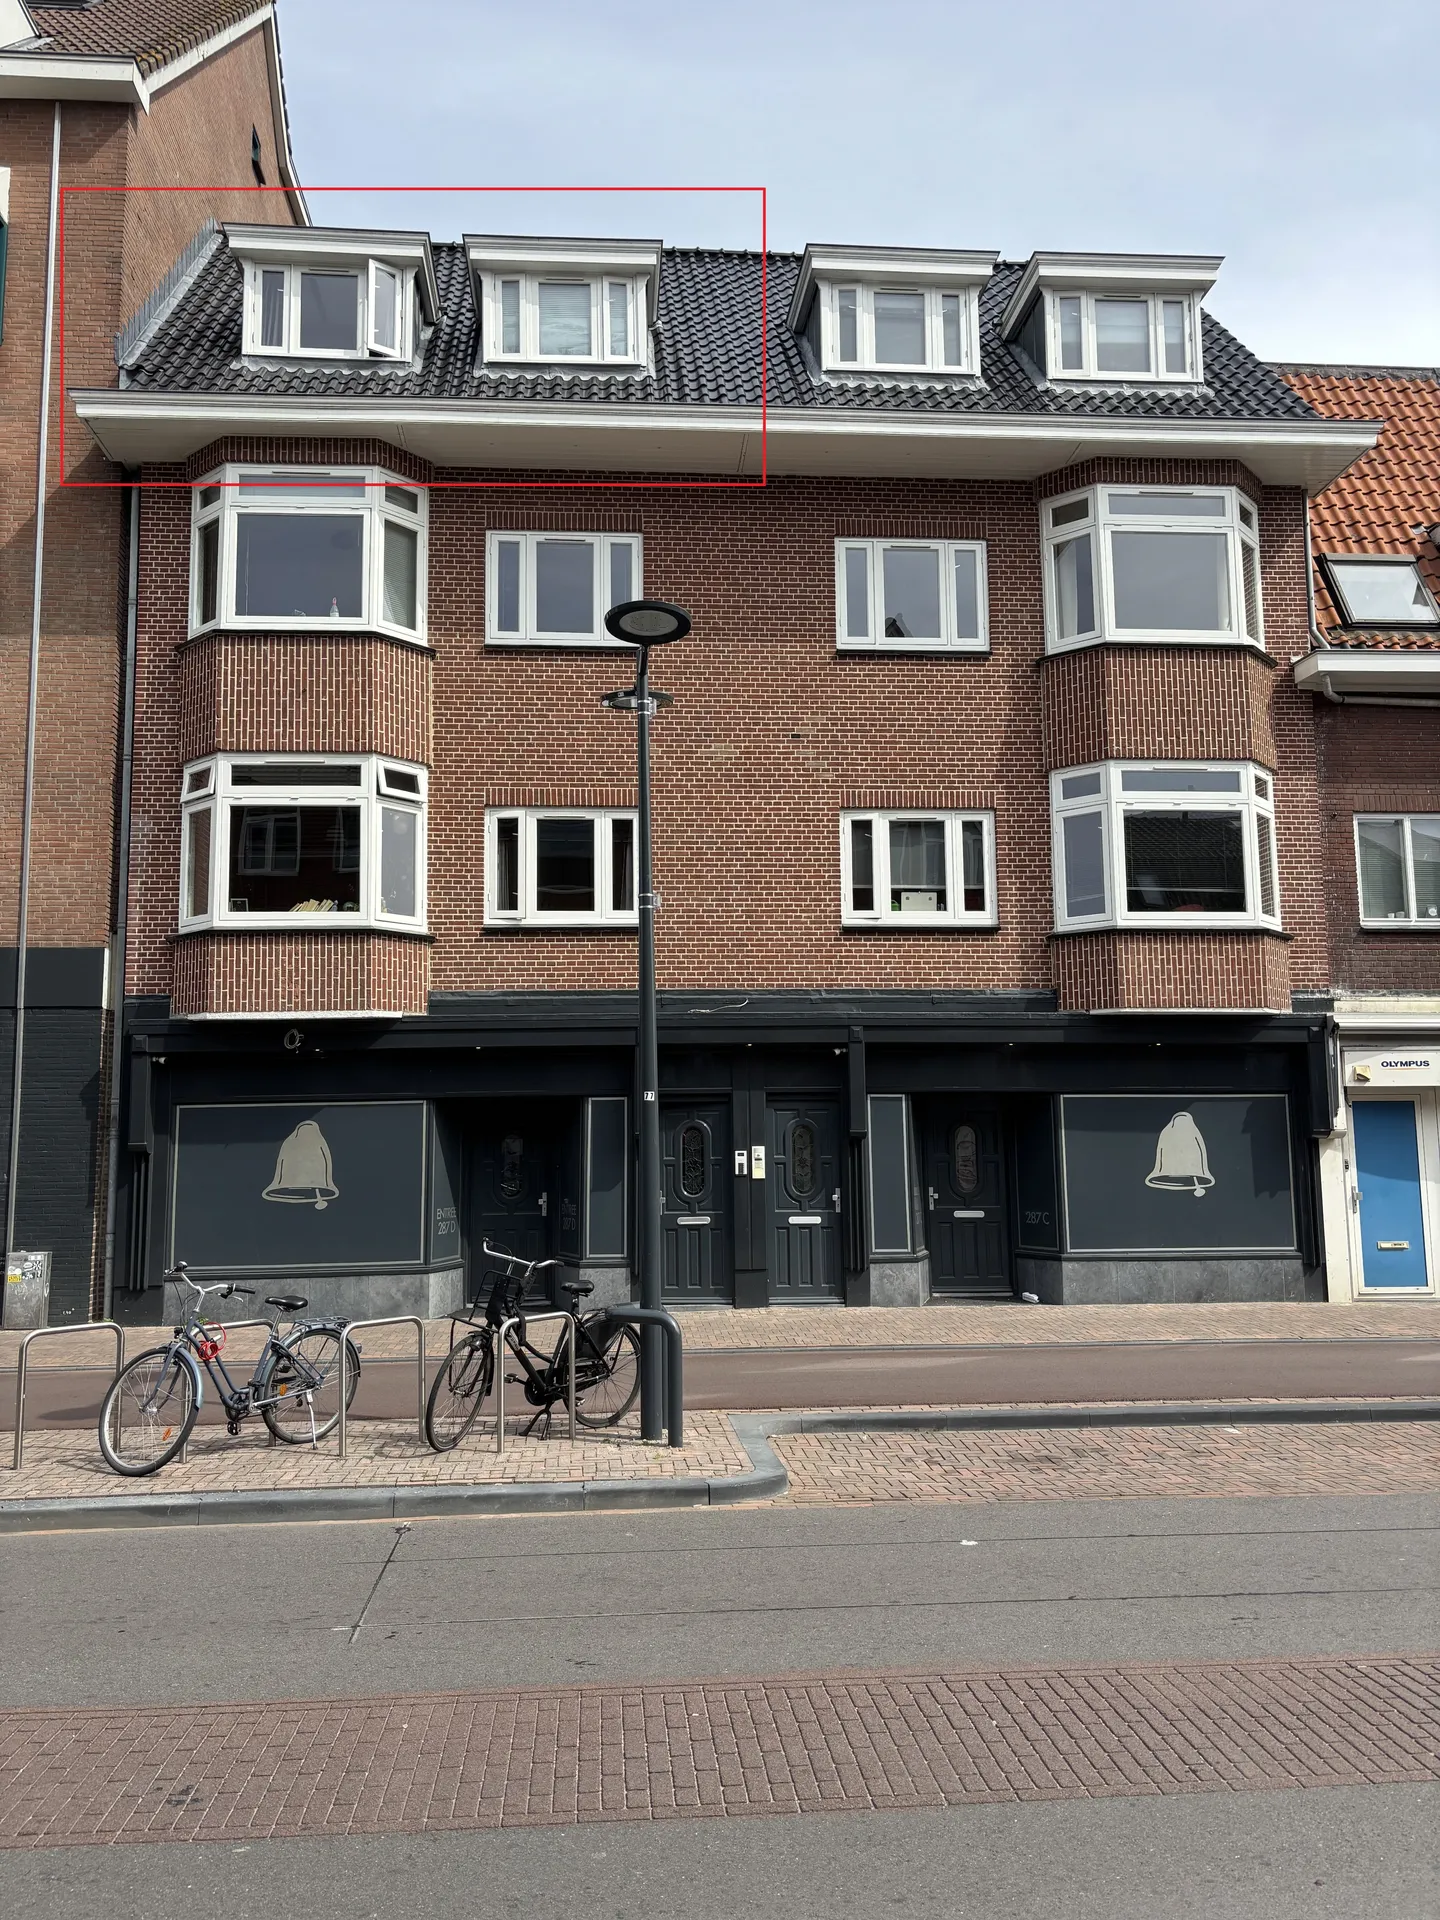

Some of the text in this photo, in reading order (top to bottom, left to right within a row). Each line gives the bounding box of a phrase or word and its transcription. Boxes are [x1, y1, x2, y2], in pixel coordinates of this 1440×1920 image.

[436, 1207, 457, 1220] ENTREE
[1025, 1211, 1050, 1225] 287 C
[437, 1220, 456, 1235] 287 D
